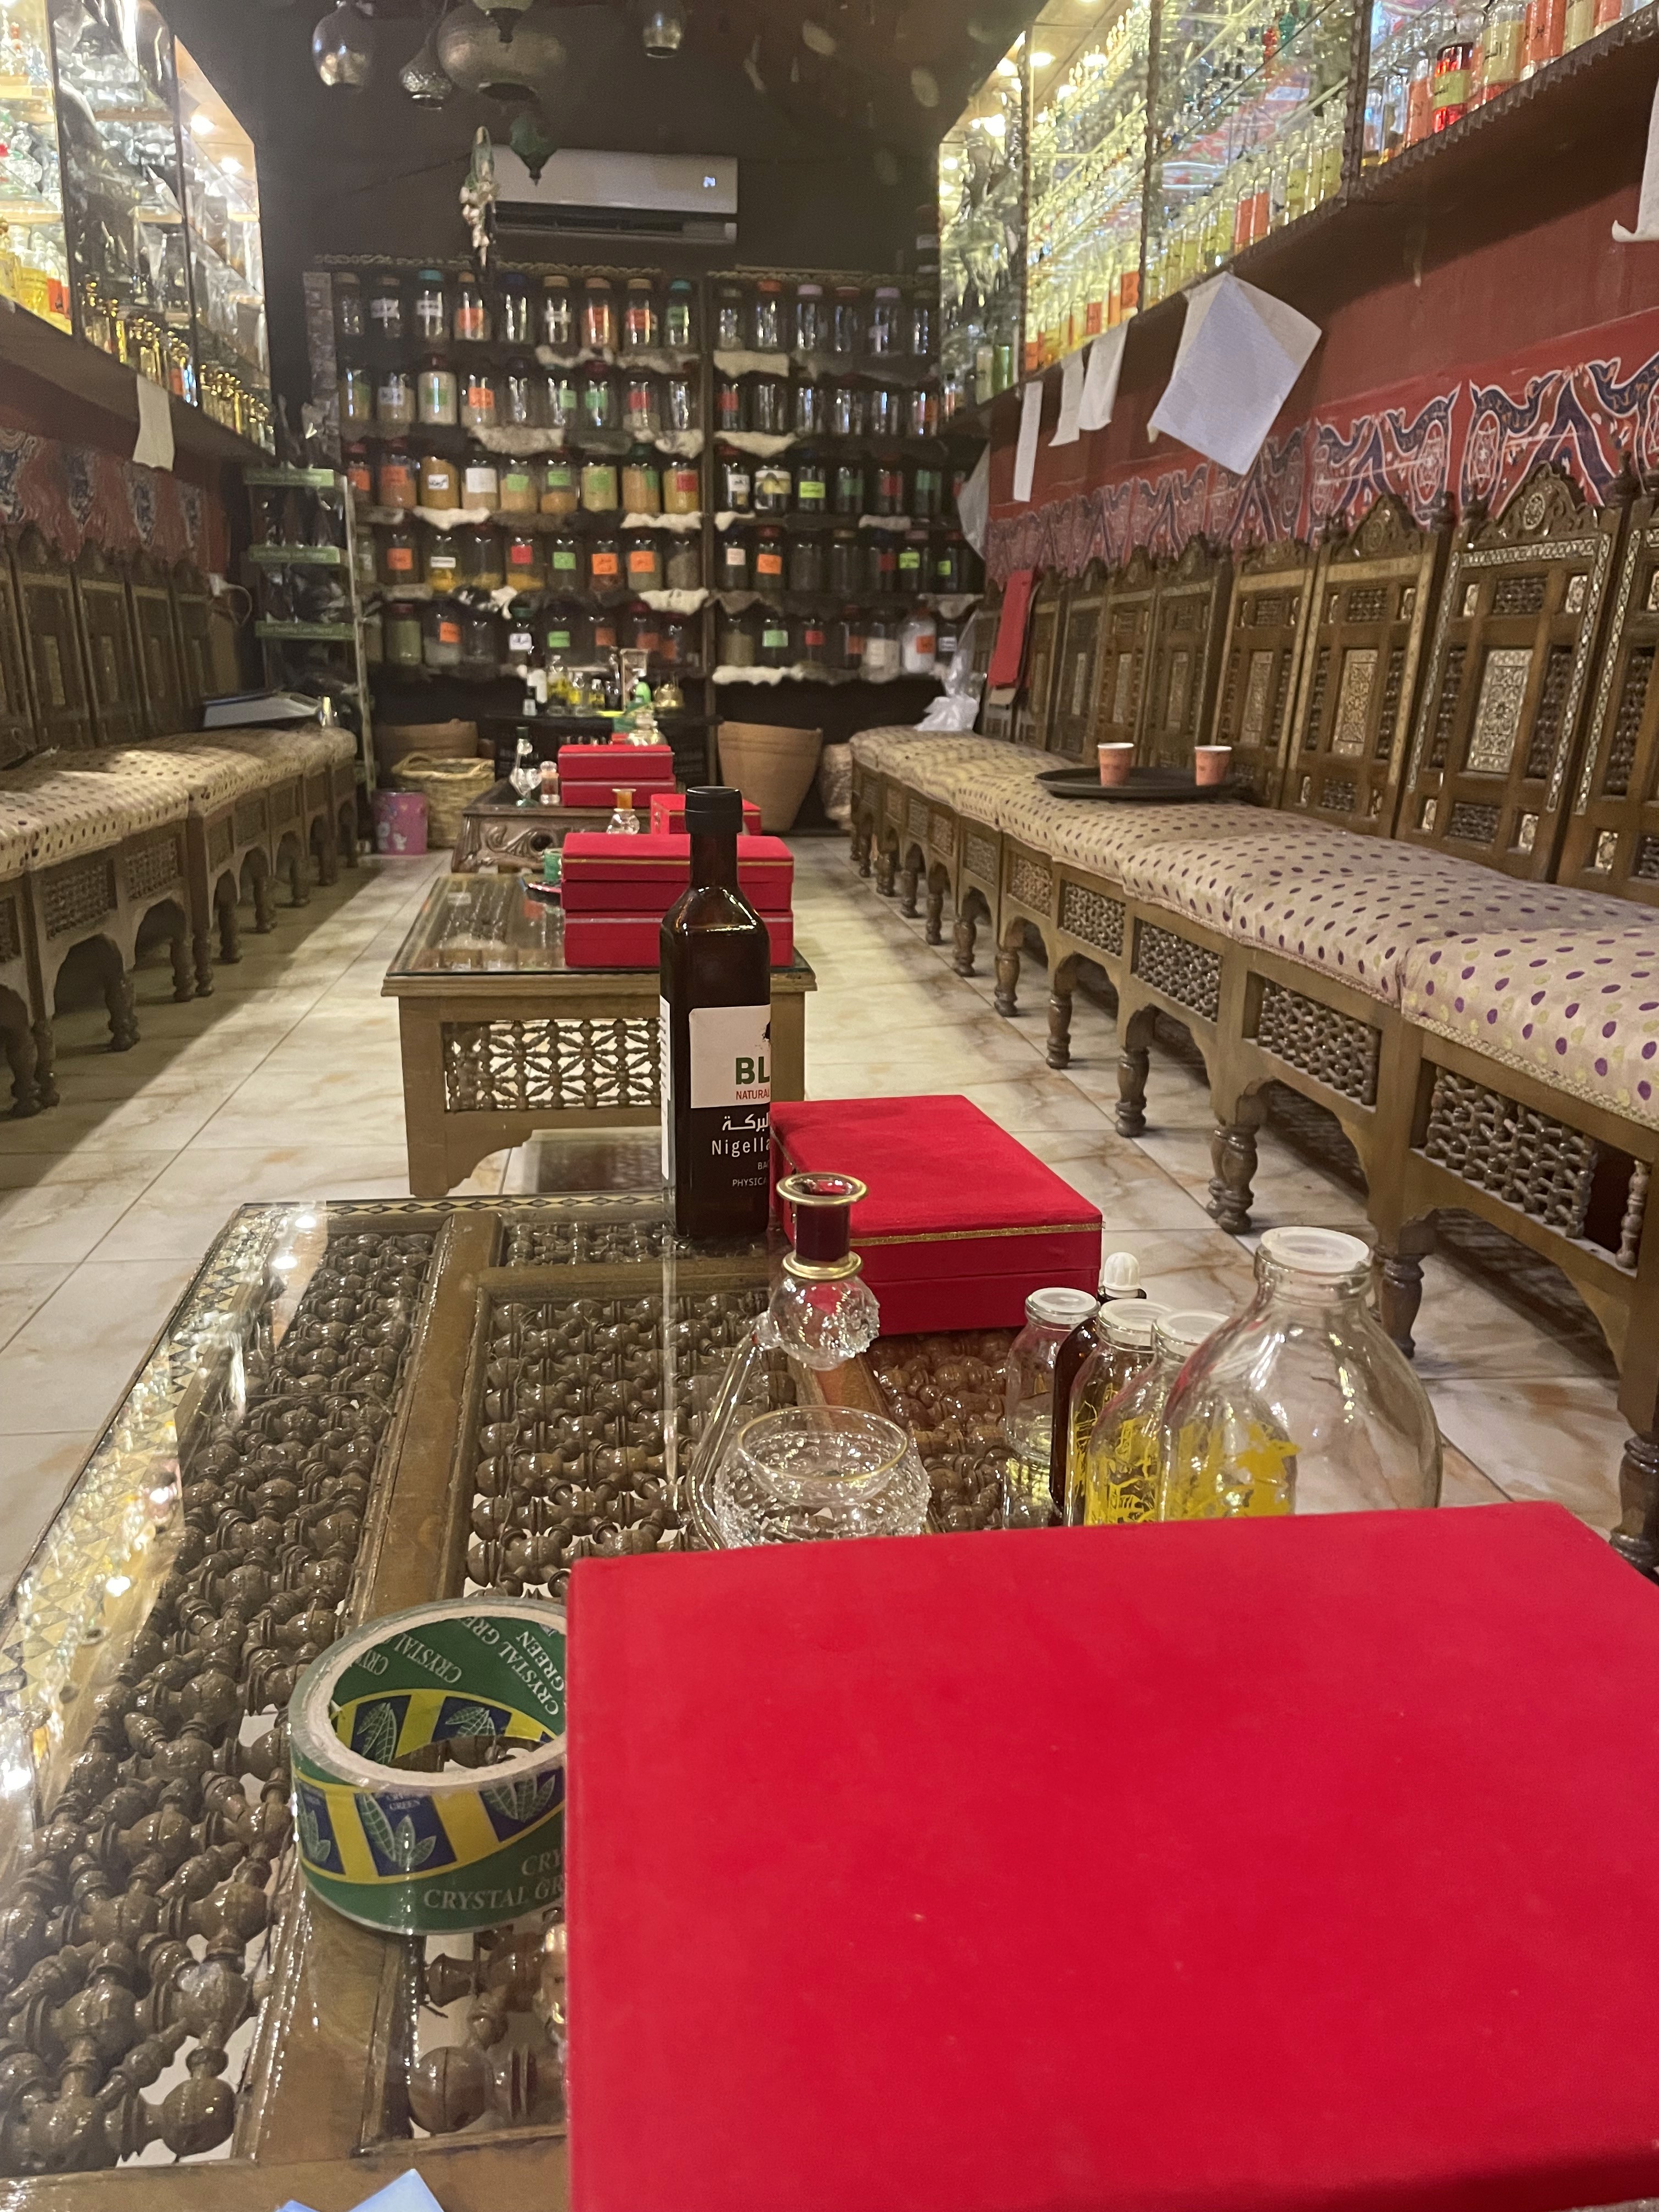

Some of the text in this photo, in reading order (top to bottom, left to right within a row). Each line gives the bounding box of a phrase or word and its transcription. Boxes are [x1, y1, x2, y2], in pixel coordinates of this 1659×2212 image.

[735, 1056, 770, 1085] BL
[498, 1641, 559, 1715] CRYSTAL
[515, 1630, 565, 1691] GREEN
[424, 1886, 527, 1910] CRYSTAL
